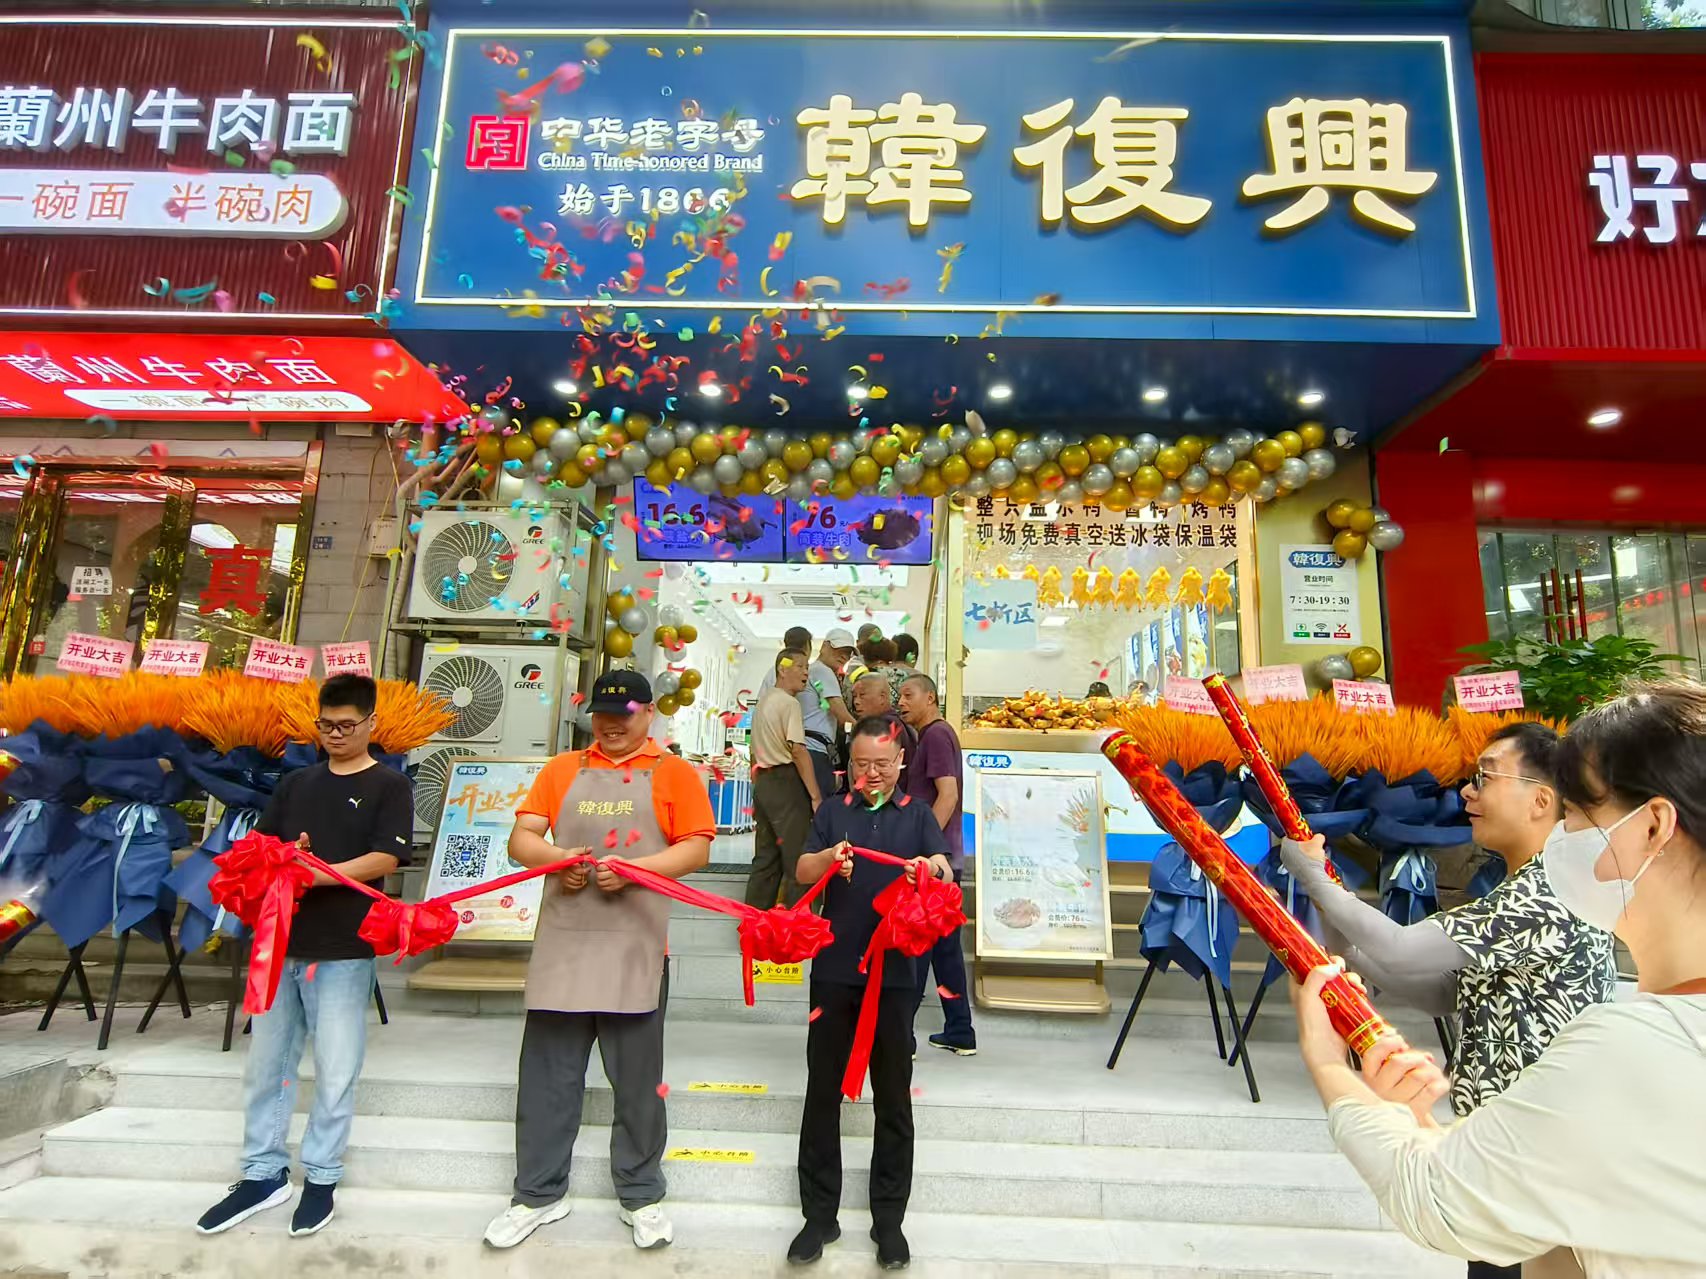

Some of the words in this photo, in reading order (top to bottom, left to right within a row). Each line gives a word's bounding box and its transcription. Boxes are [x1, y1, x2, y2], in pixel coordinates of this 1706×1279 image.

[0, 86, 353, 156] 蘭州牛肉面
[540, 115, 765, 152] 中华老字号
[538, 151, 586, 170] China
[591, 151, 709, 172] Time-honored
[713, 153, 763, 172] Brand
[790, 92, 1437, 231] 韓復興
[0, 179, 135, 221] 一碗面
[164, 181, 313, 225] 半碗肉
[199, 544, 273, 617] 真
[67, 643, 127, 664] 开业大吉
[149, 649, 202, 664] 开业大吉
[253, 649, 308, 669] 开业大吉
[327, 652, 367, 667] 开业大吉
[1168, 688, 1212, 702] 开业大
[1338, 689, 1388, 705] 开业大吉
[1461, 682, 1516, 699] 开业大吉
[576, 800, 634, 816] 韓復興
